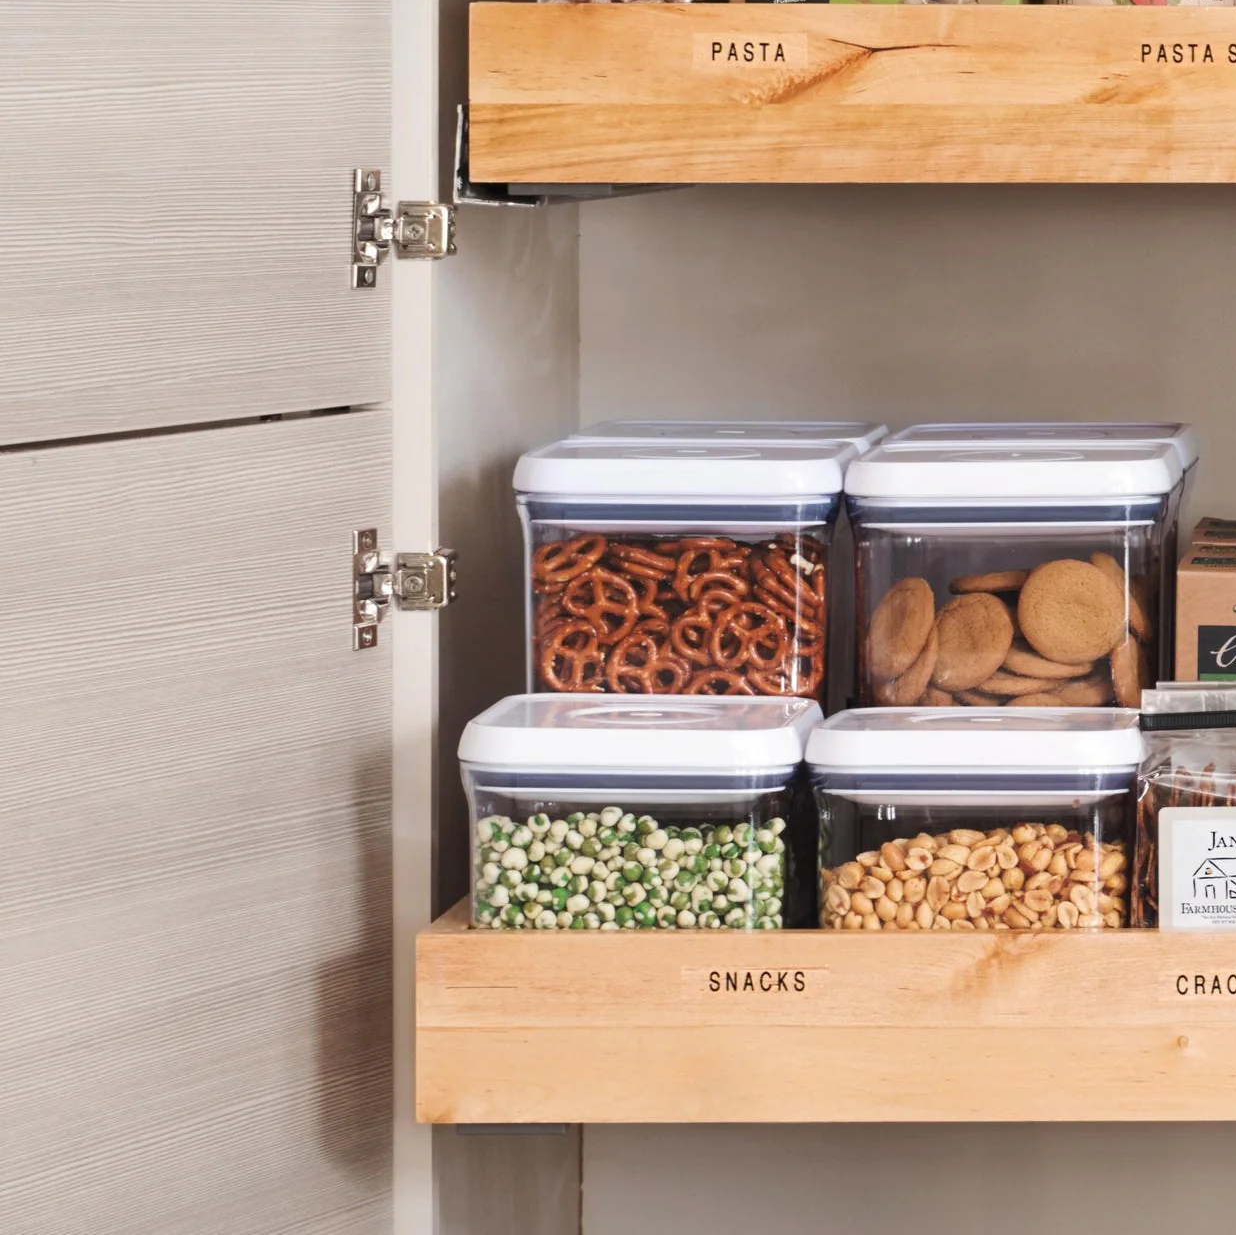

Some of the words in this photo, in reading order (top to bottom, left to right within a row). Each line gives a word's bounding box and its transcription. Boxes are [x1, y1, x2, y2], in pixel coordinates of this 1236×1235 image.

[711, 41, 786, 63] PASTA
[1141, 43, 1216, 65] PASTA
[708, 971, 807, 993] SNACKS
